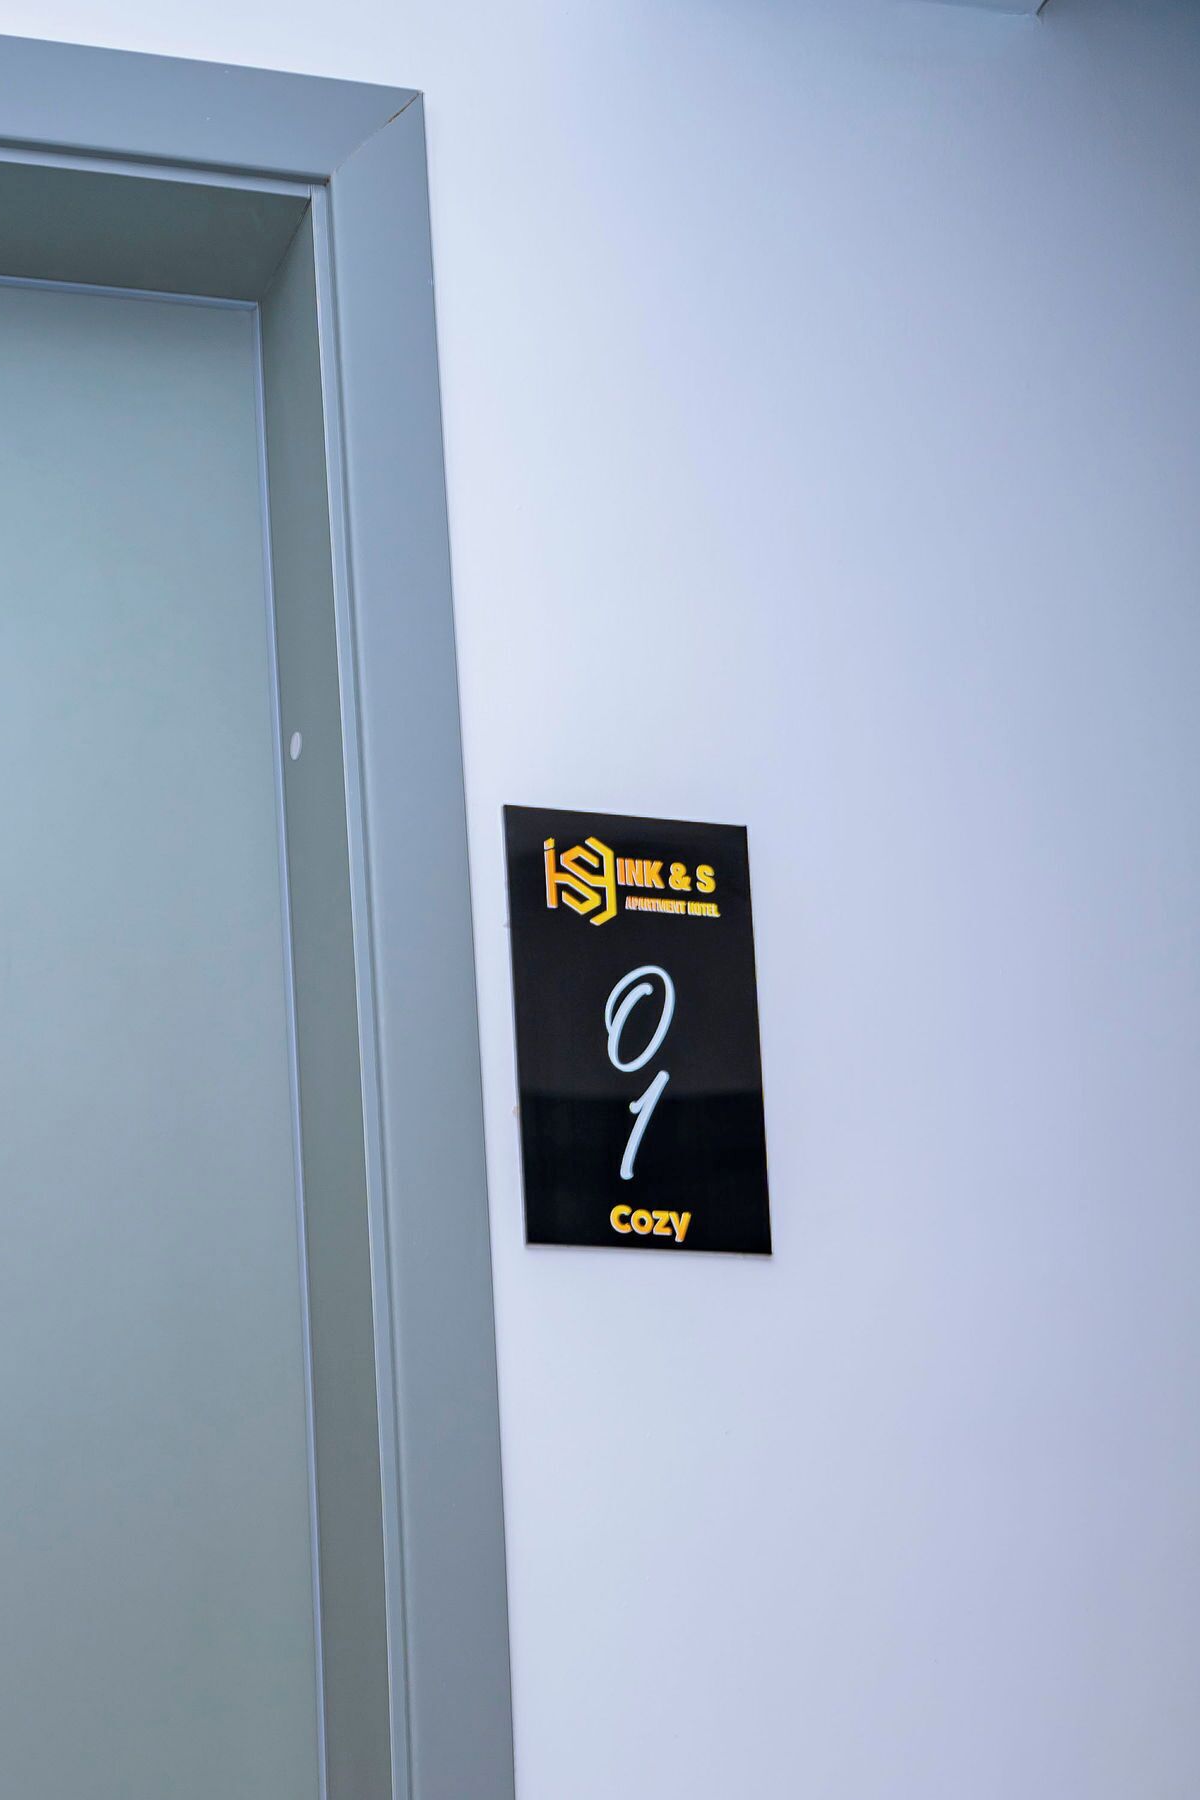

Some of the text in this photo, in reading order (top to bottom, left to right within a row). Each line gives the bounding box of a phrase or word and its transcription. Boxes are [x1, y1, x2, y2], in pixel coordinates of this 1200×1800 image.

[616, 857, 716, 894] INK & S
[624, 895, 721, 918] APARTMENT HOTEL
[609, 1203, 692, 1243] Cozy
